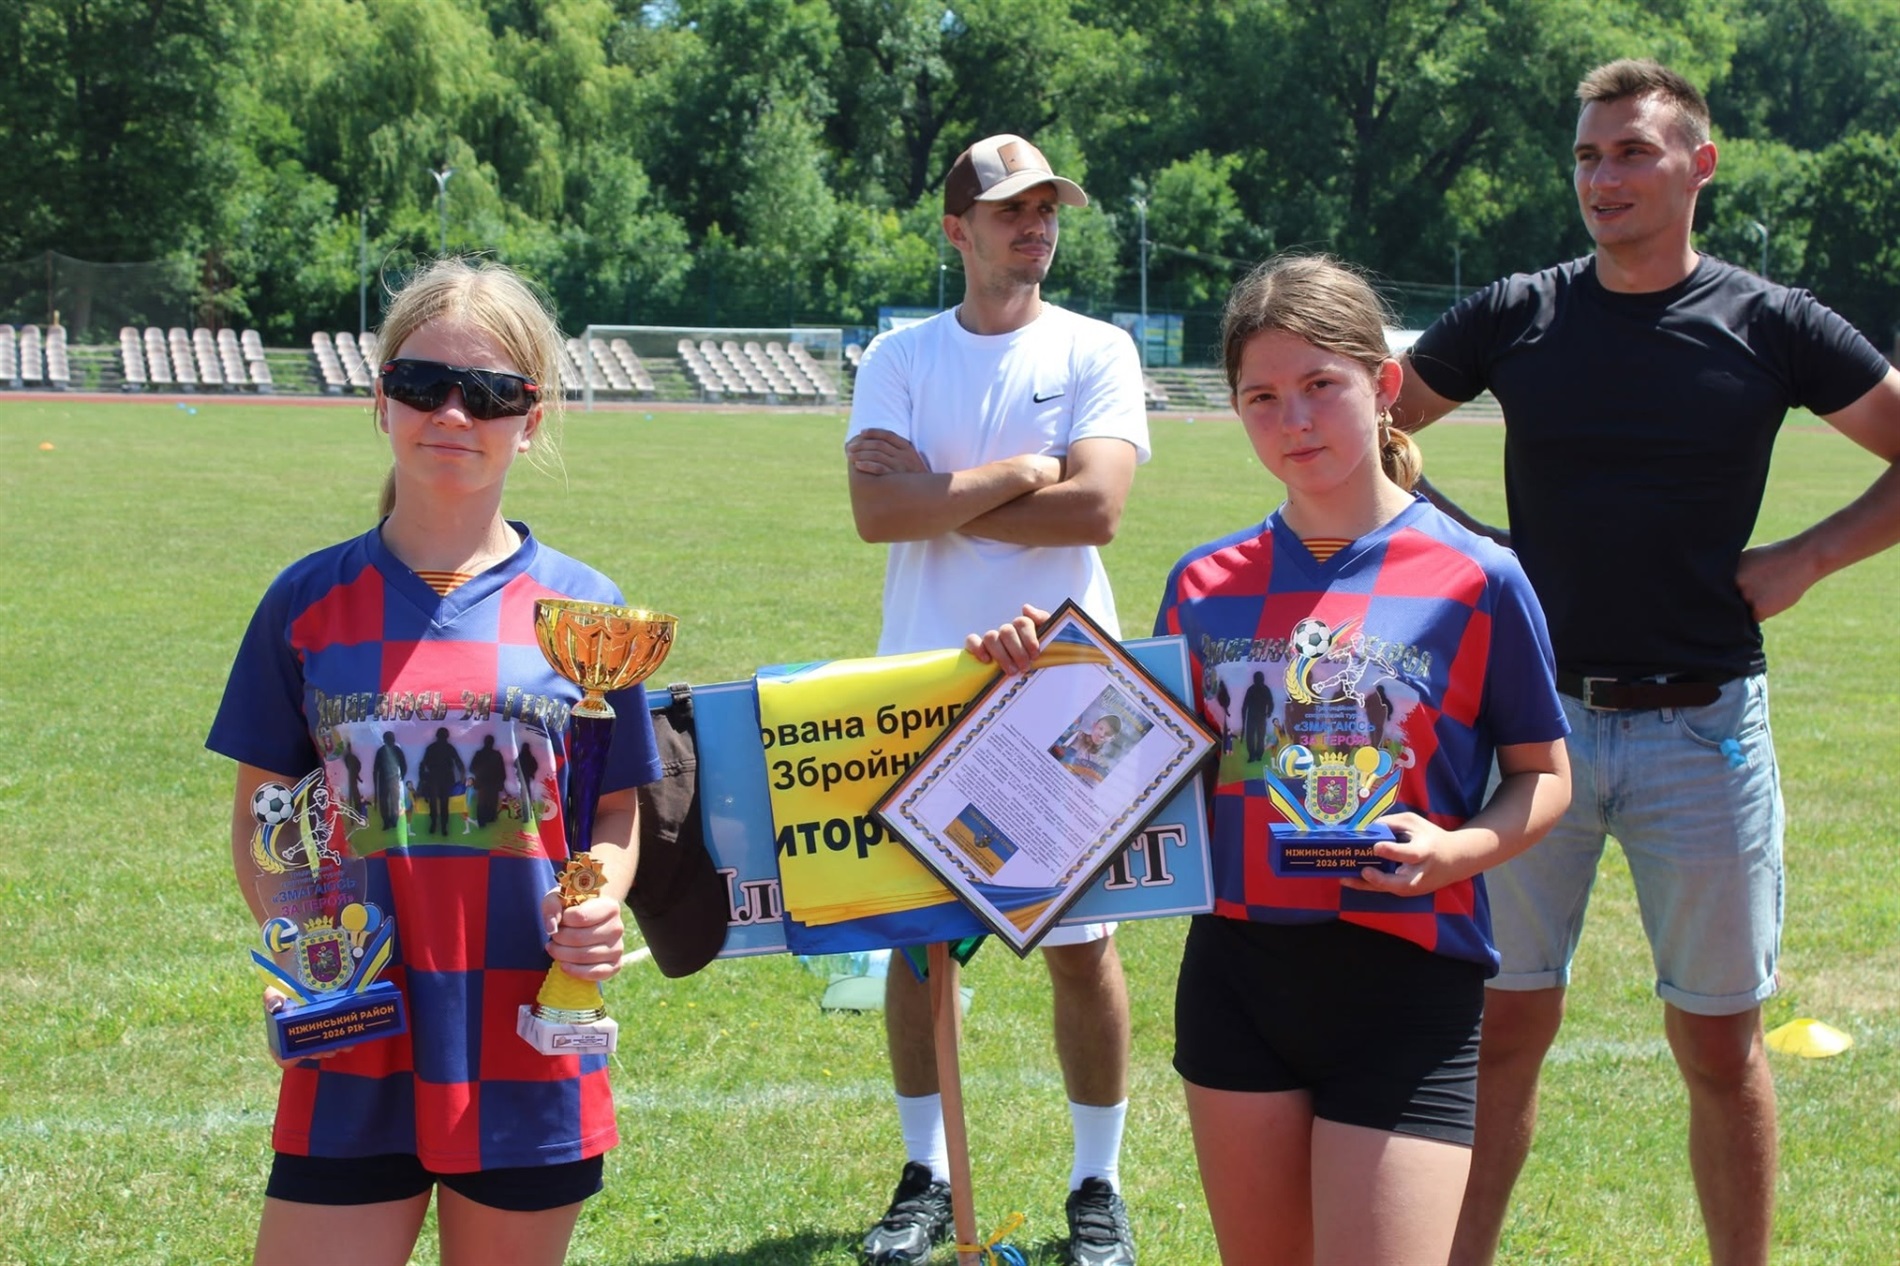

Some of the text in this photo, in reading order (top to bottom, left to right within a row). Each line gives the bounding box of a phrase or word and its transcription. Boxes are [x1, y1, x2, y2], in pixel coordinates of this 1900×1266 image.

[876, 702, 971, 739] бриг
[776, 813, 898, 859] итор
[1285, 846, 1376, 857] НІЖИНСЬКИЙ РАЙ
[1316, 859, 1357, 868] 2026 РІК
[281, 904, 299, 918] ЗА
[288, 1004, 395, 1036] НІЖИНСЬКИЙ РАЙОН
[322, 1023, 365, 1040] 2026 РІК
